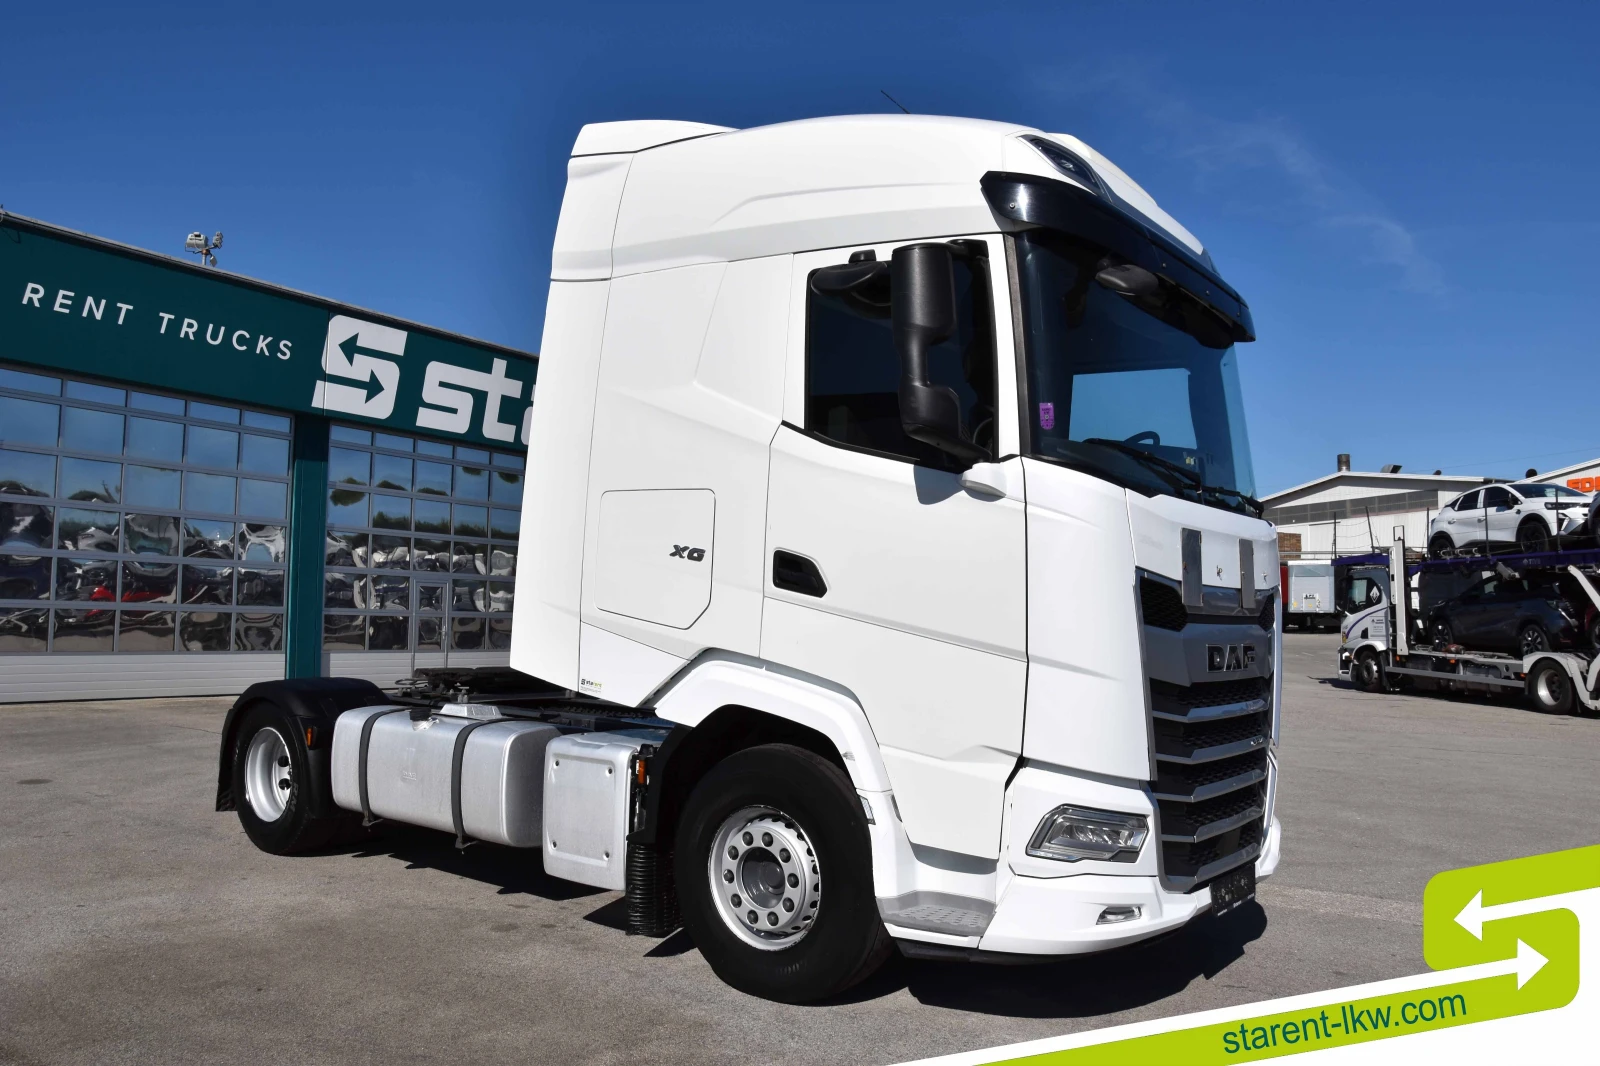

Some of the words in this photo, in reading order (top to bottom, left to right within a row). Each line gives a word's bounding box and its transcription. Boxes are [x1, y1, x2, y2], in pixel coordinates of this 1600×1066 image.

[22, 282, 134, 325] RENT
[158, 312, 293, 360] TRUCKS
[669, 544, 706, 562] XG
[1206, 644, 1256, 673] DAF
